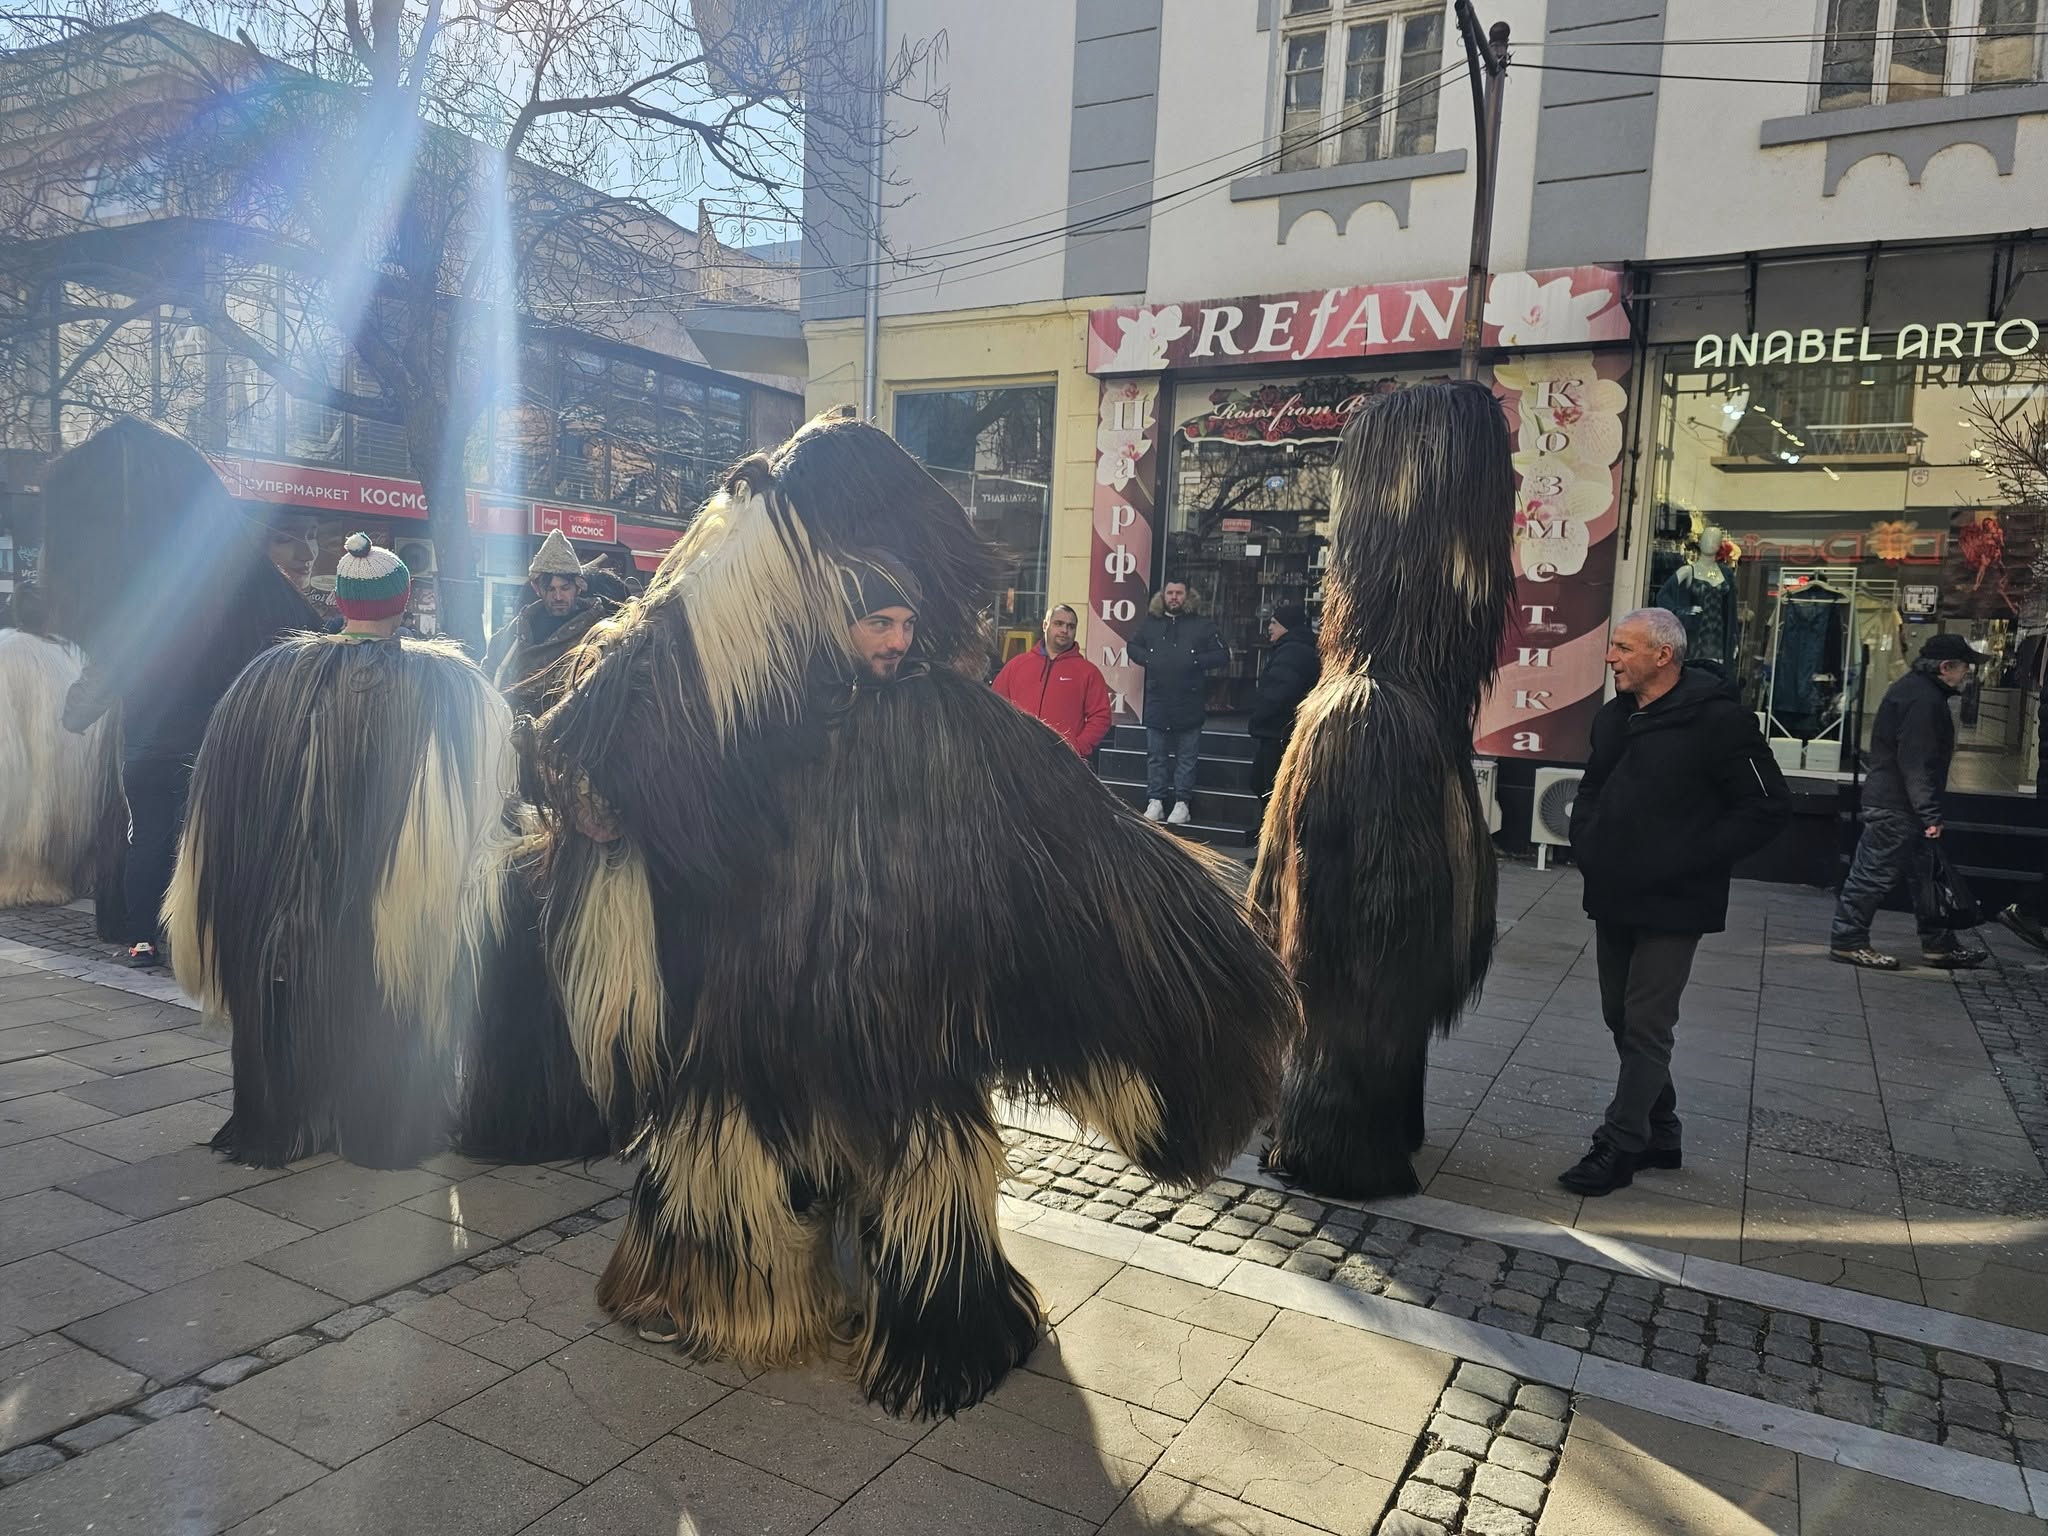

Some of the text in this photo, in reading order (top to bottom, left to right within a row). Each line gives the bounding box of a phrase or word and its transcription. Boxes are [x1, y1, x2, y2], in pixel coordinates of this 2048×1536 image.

[1694, 318, 2040, 368] ANABEL ARTO
[1208, 402, 1274, 420] Roses
[1268, 393, 1332, 432] from
[245, 477, 350, 501] СУПЕРМАРКЕТ
[360, 487, 428, 511] КОСМО
[571, 525, 604, 537] КОСМОС
[1511, 379, 1584, 753] Козметика
